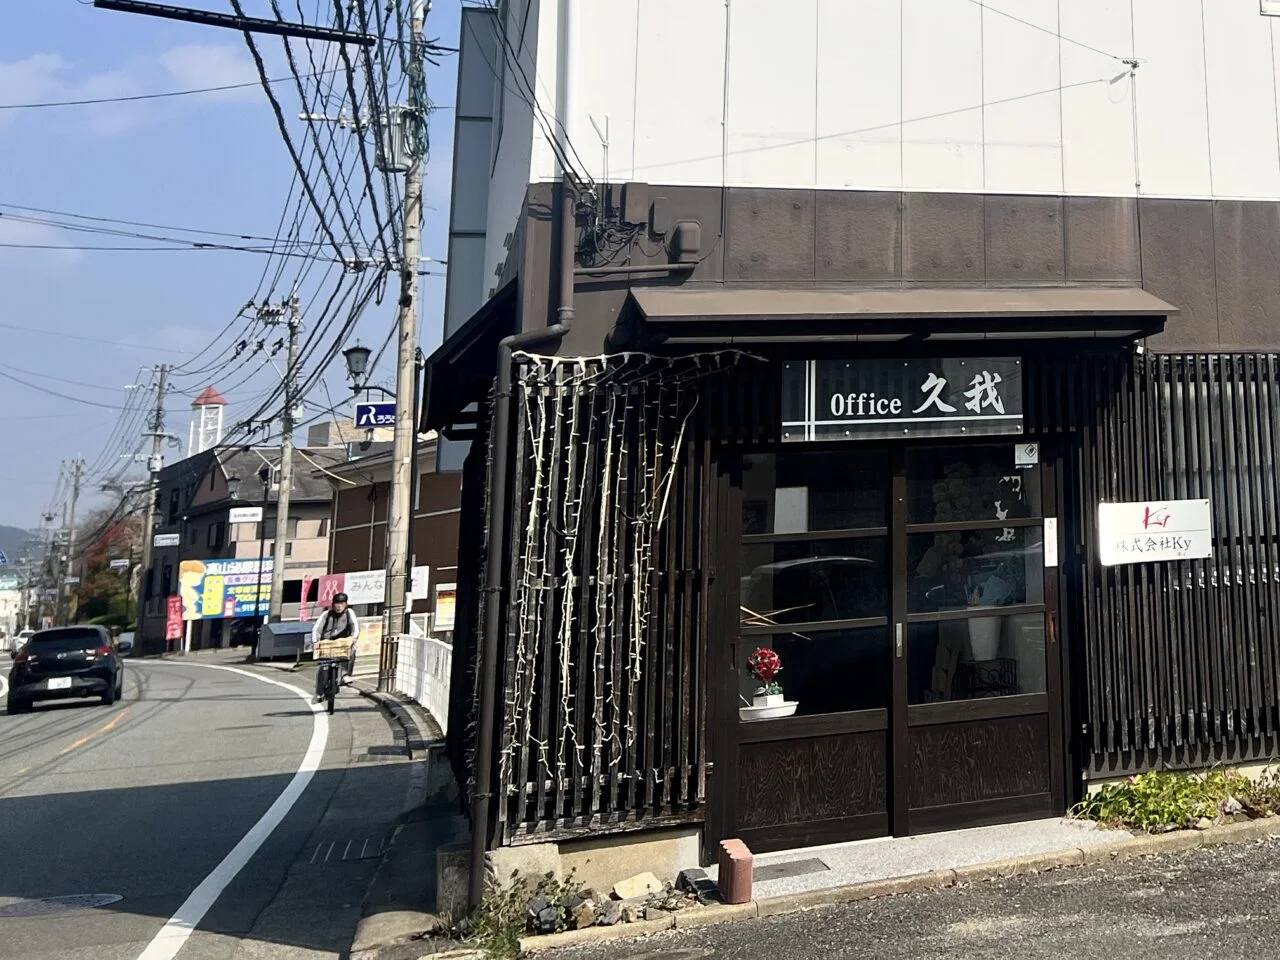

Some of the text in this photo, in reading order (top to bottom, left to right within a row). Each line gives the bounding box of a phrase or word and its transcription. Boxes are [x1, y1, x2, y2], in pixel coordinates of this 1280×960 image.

[830, 370, 1005, 416] Office 久我
[1116, 536, 1192, 553] 株式会社Ky
